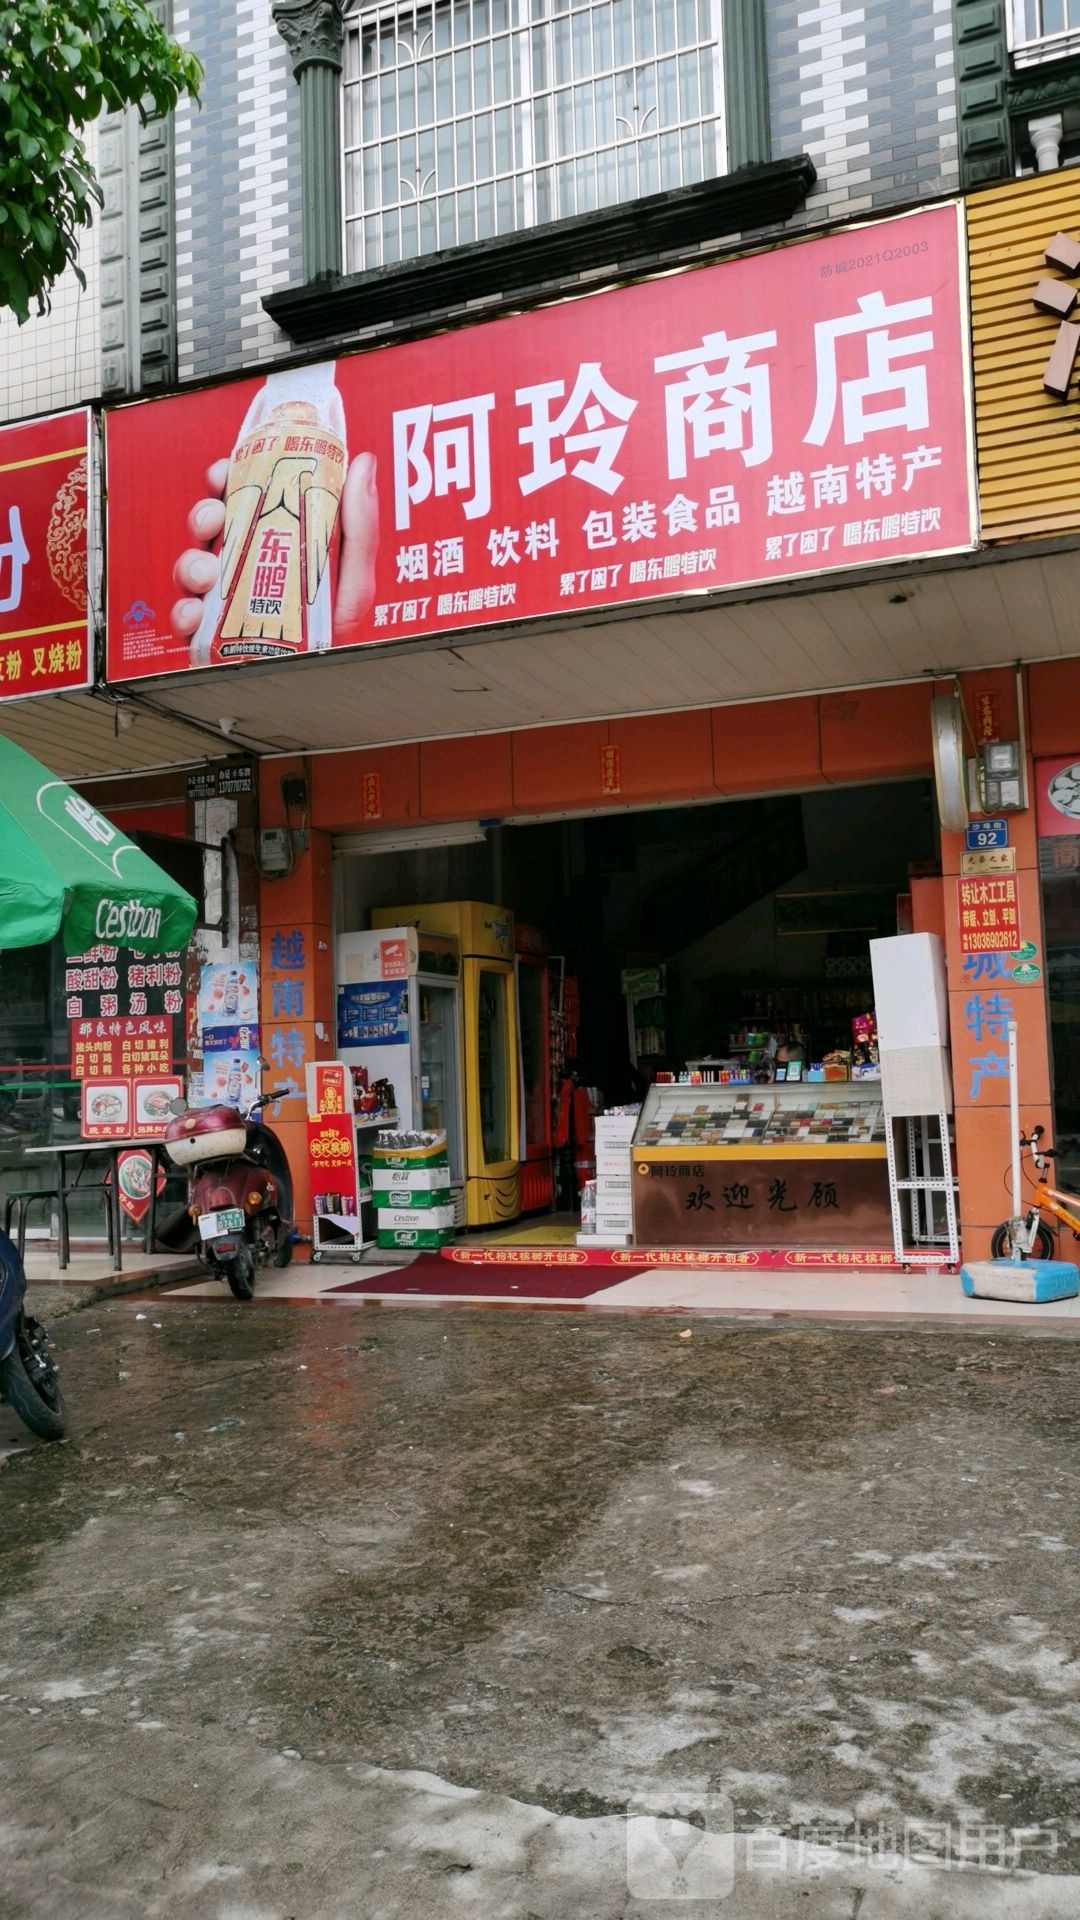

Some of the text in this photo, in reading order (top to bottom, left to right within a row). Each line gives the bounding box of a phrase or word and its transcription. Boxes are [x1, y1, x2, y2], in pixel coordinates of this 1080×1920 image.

[392, 290, 934, 531] 阿玲商店
[396, 445, 942, 584] 烟酒 饮料 包装食品 越南特产
[765, 507, 942, 561] 累了困了 喝东鹏特饮
[252, 528, 293, 598] 东鹏
[560, 548, 717, 596] 累了困了 喝东鹏特饮
[250, 599, 282, 615] 特饮
[374, 583, 517, 627] 累了困了 喝东鹏特饮
[0, 649, 22, 682] 粉
[32, 639, 82, 676] 叉烧粉
[977, 832, 997, 846] 92
[962, 880, 1015, 905] 转让木工工具
[969, 930, 1017, 949] 13036902612
[66, 962, 182, 991] 酸甜粉 猪利粉
[79, 1020, 167, 1037] 那良特色风味
[651, 1164, 705, 1179] 阿玲商店
[685, 1178, 840, 1212] 欢迎光顾
[460, 1250, 580, 1262] 新一代枸杞槟榔开创者
